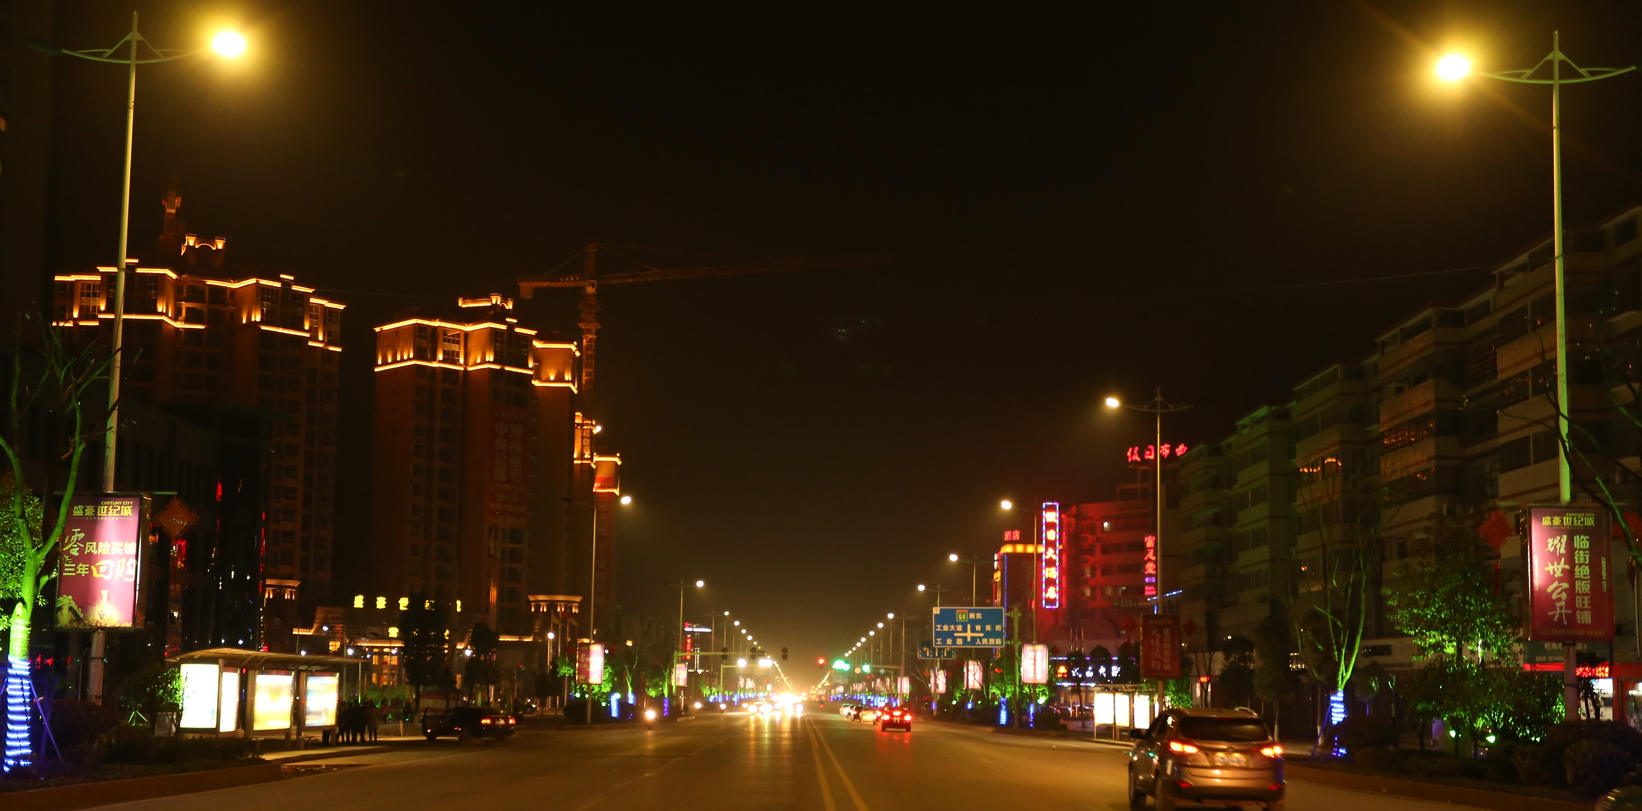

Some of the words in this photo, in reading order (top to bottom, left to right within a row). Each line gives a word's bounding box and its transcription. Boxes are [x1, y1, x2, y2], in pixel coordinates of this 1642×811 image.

[73, 505, 133, 516] 盛豪世纪城
[1542, 516, 1594, 526] 盛豪世纪城
[62, 558, 137, 582] 三年回购
[1573, 535, 1592, 625] 临街绝版旺铺
